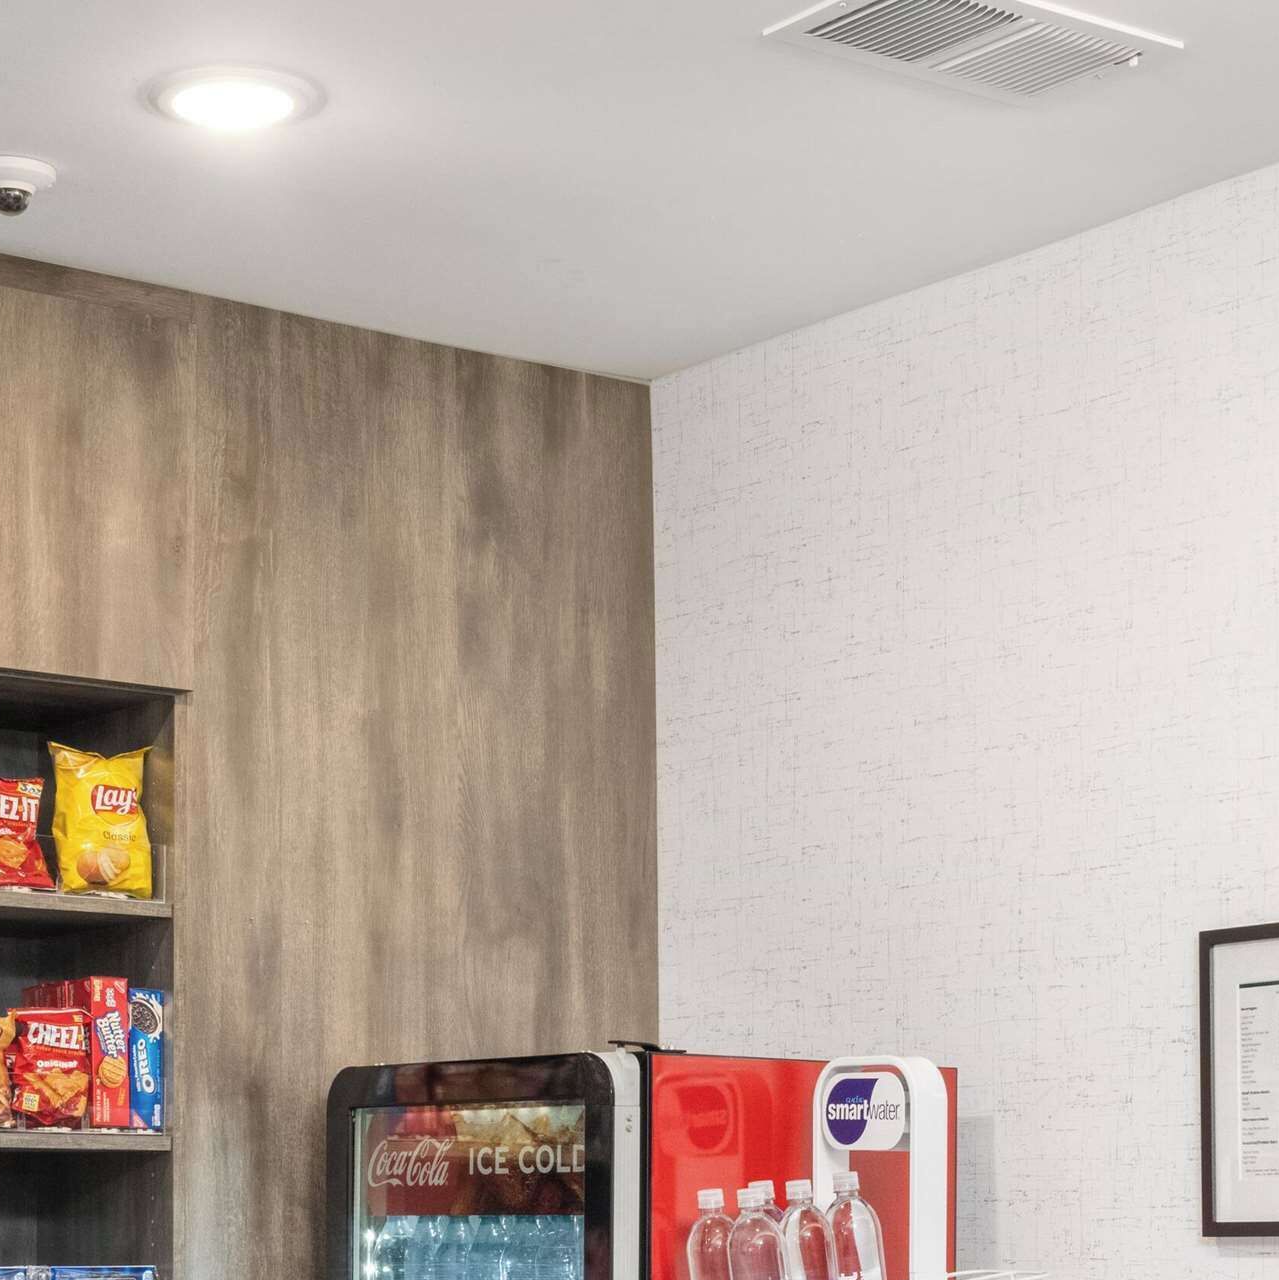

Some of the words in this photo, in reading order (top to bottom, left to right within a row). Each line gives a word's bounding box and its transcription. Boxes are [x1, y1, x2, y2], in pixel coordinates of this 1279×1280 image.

[96, 1017, 118, 1059] Butter
[107, 1010, 126, 1053] Nutter
[137, 1038, 155, 1094] OREO
[828, 1099, 900, 1121] smartwater
[368, 1138, 453, 1188] Coca-Cola
[469, 1147, 509, 1175] ICE
[518, 1144, 585, 1174] COLD
